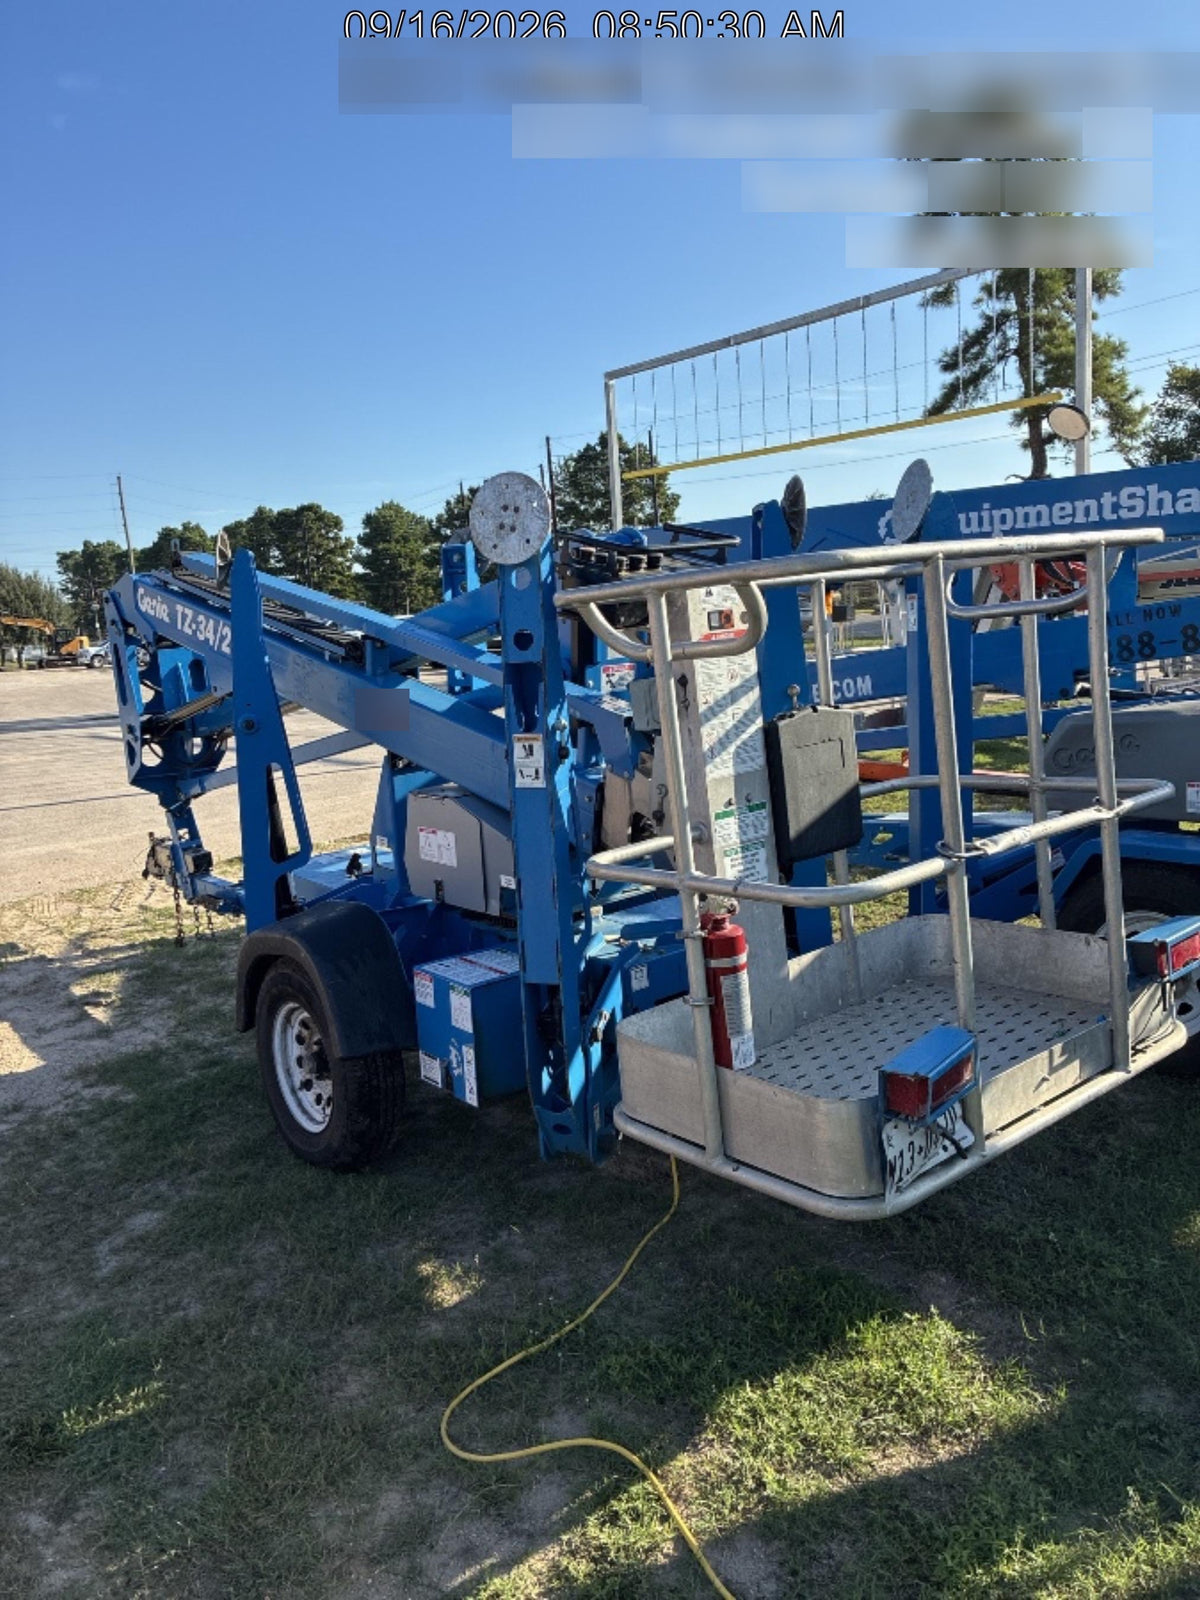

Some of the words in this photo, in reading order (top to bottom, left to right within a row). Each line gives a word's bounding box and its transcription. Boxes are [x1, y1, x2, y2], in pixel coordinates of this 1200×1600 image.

[958, 483, 1200, 537] uipmentSha
[176, 604, 232, 655] TZ-34/2
[1143, 603, 1182, 622] NOW
[1107, 623, 1200, 665] 88-8
